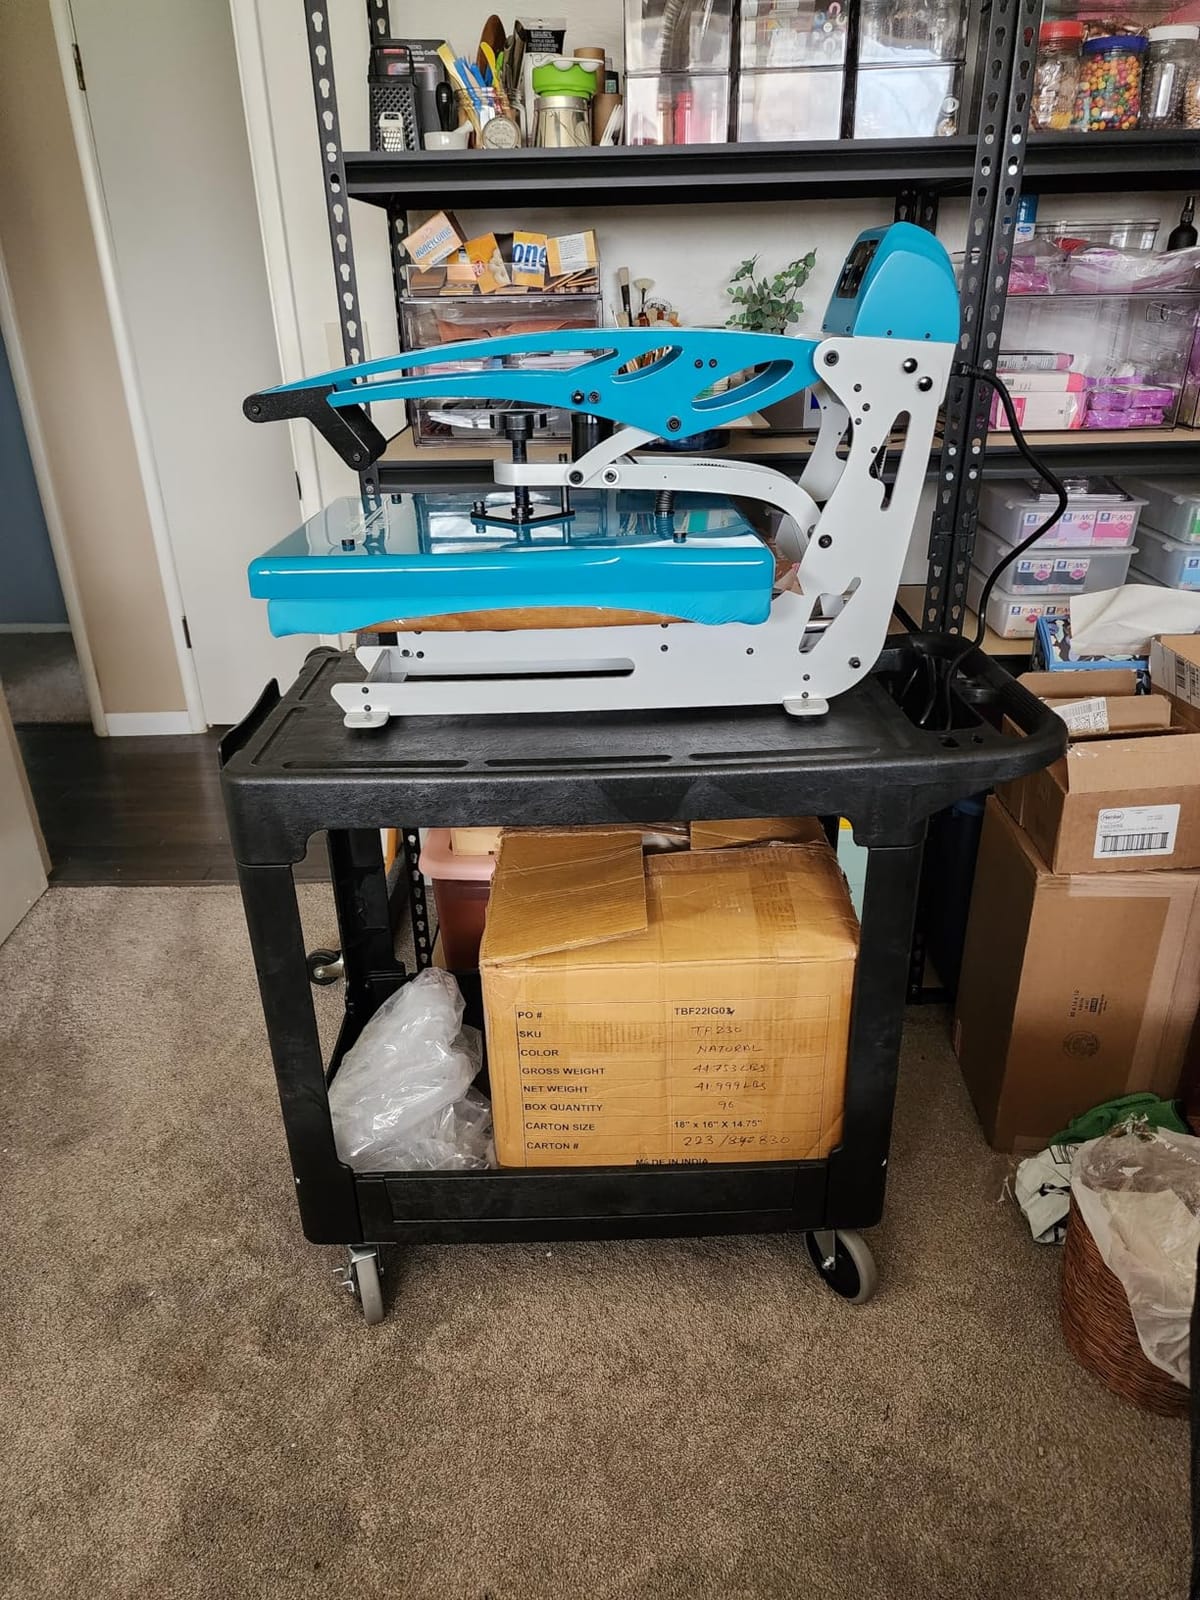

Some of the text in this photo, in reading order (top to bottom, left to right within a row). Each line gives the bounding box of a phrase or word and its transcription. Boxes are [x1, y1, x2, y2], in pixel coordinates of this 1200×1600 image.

[517, 1011, 534, 1019] PO
[520, 1049, 560, 1057] COLOR
[522, 1067, 560, 1075] GROSS
[523, 1085, 589, 1093] NET WEIGHT
[524, 1103, 603, 1112] BOX QUANTITY
[525, 1122, 596, 1131] CARTON SIZE
[526, 1142, 570, 1150] CARTON
